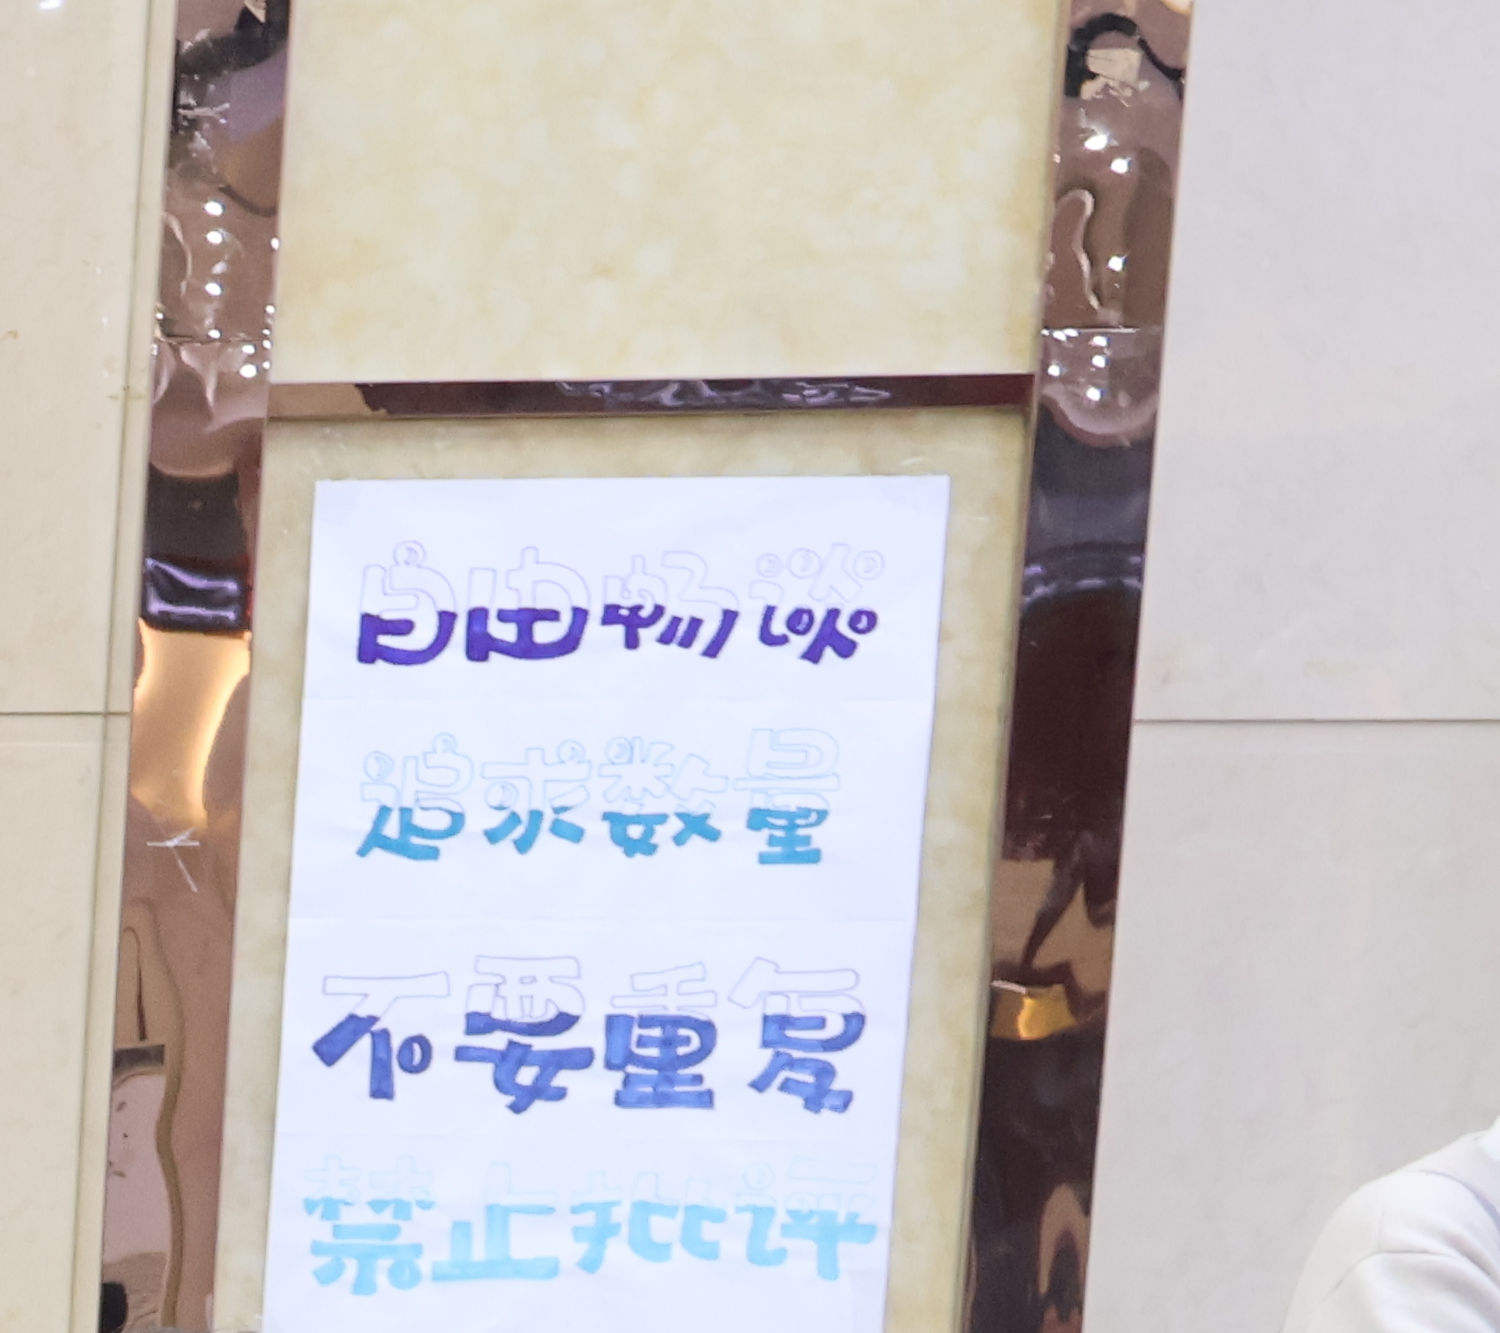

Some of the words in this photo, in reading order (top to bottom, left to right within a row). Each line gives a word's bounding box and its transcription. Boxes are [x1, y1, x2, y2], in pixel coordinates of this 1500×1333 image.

[357, 539, 886, 664] 自由畅谈
[356, 728, 840, 865] 追求数量
[312, 955, 866, 1114] 不要重复
[303, 1155, 878, 1296] 禁止批评
